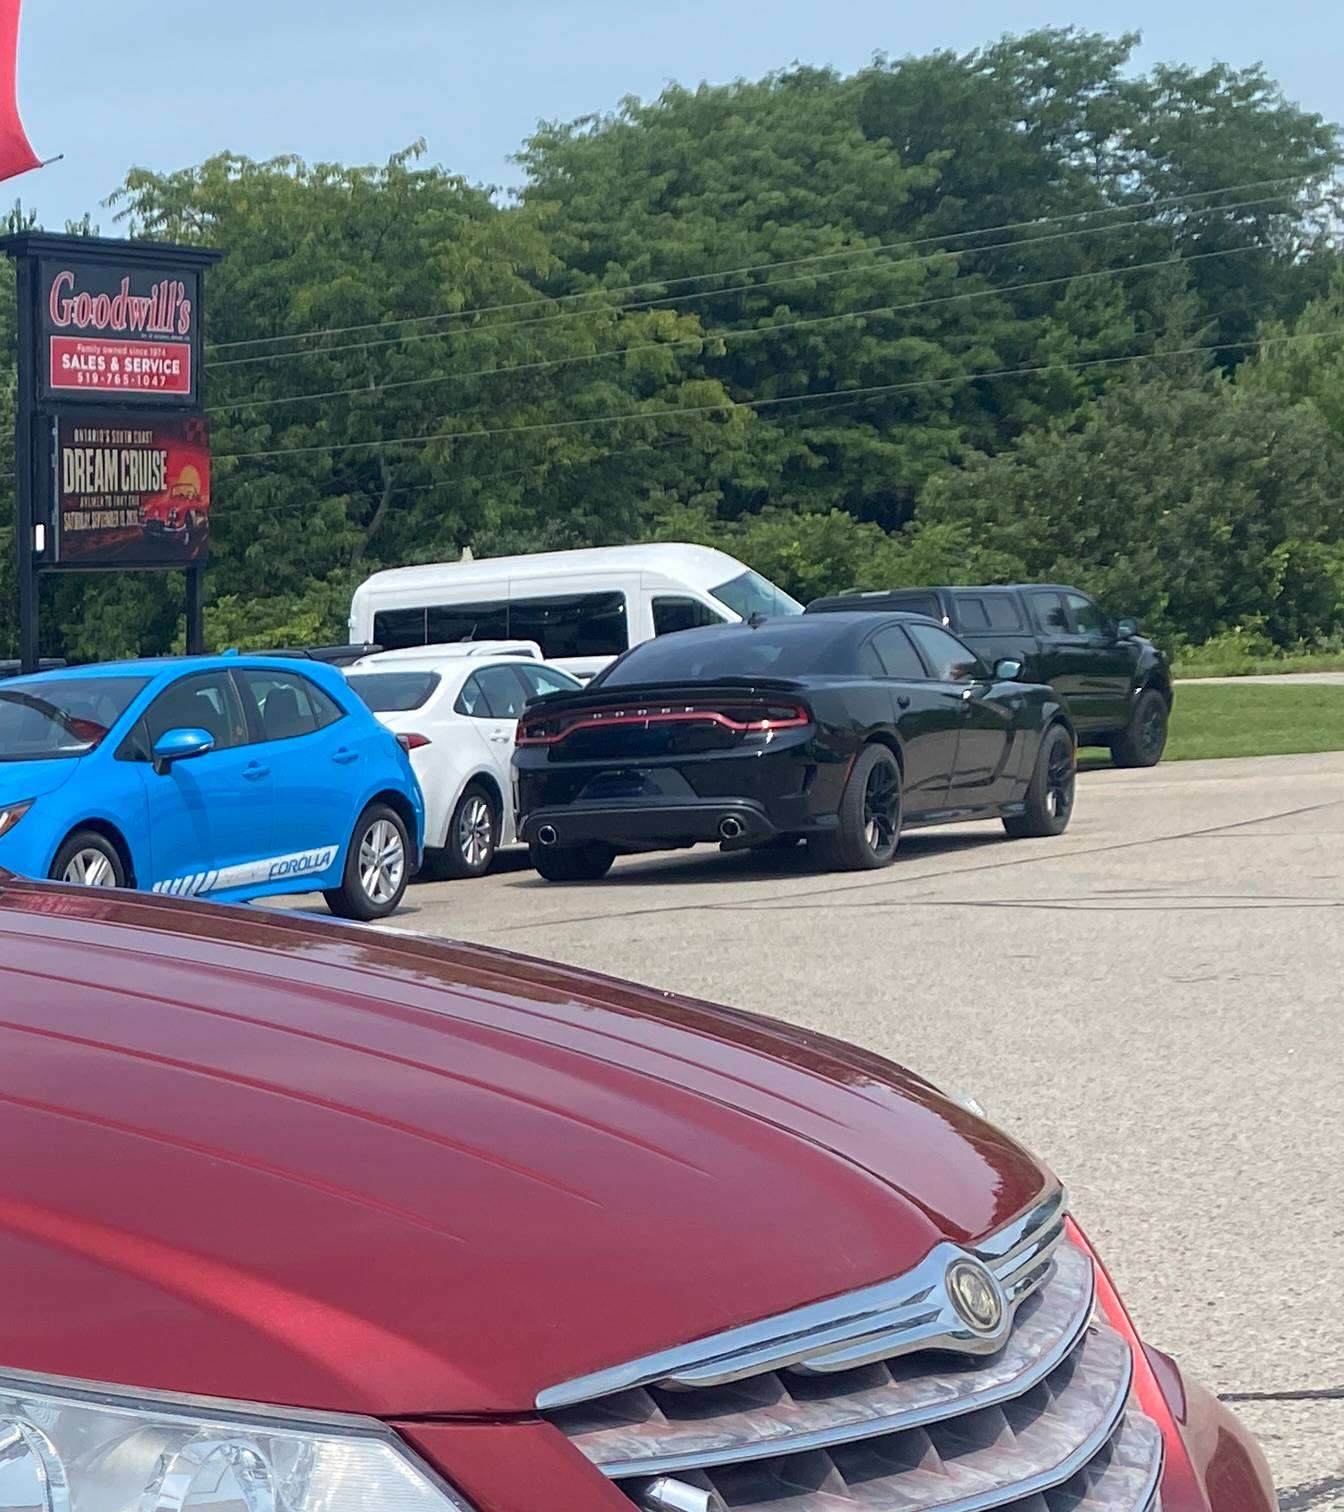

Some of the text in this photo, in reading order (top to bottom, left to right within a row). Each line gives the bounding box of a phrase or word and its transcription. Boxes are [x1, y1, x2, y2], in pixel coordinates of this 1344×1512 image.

[50, 271, 191, 333] Goodwill's
[77, 343, 100, 354] Family
[103, 347, 127, 355] owned
[130, 347, 147, 356] since
[62, 354, 180, 375] SALES & SERVICE
[74, 428, 110, 443] ONTARIO'S
[63, 448, 168, 493] DREAM CRUISE
[269, 850, 332, 878] COROLLA
